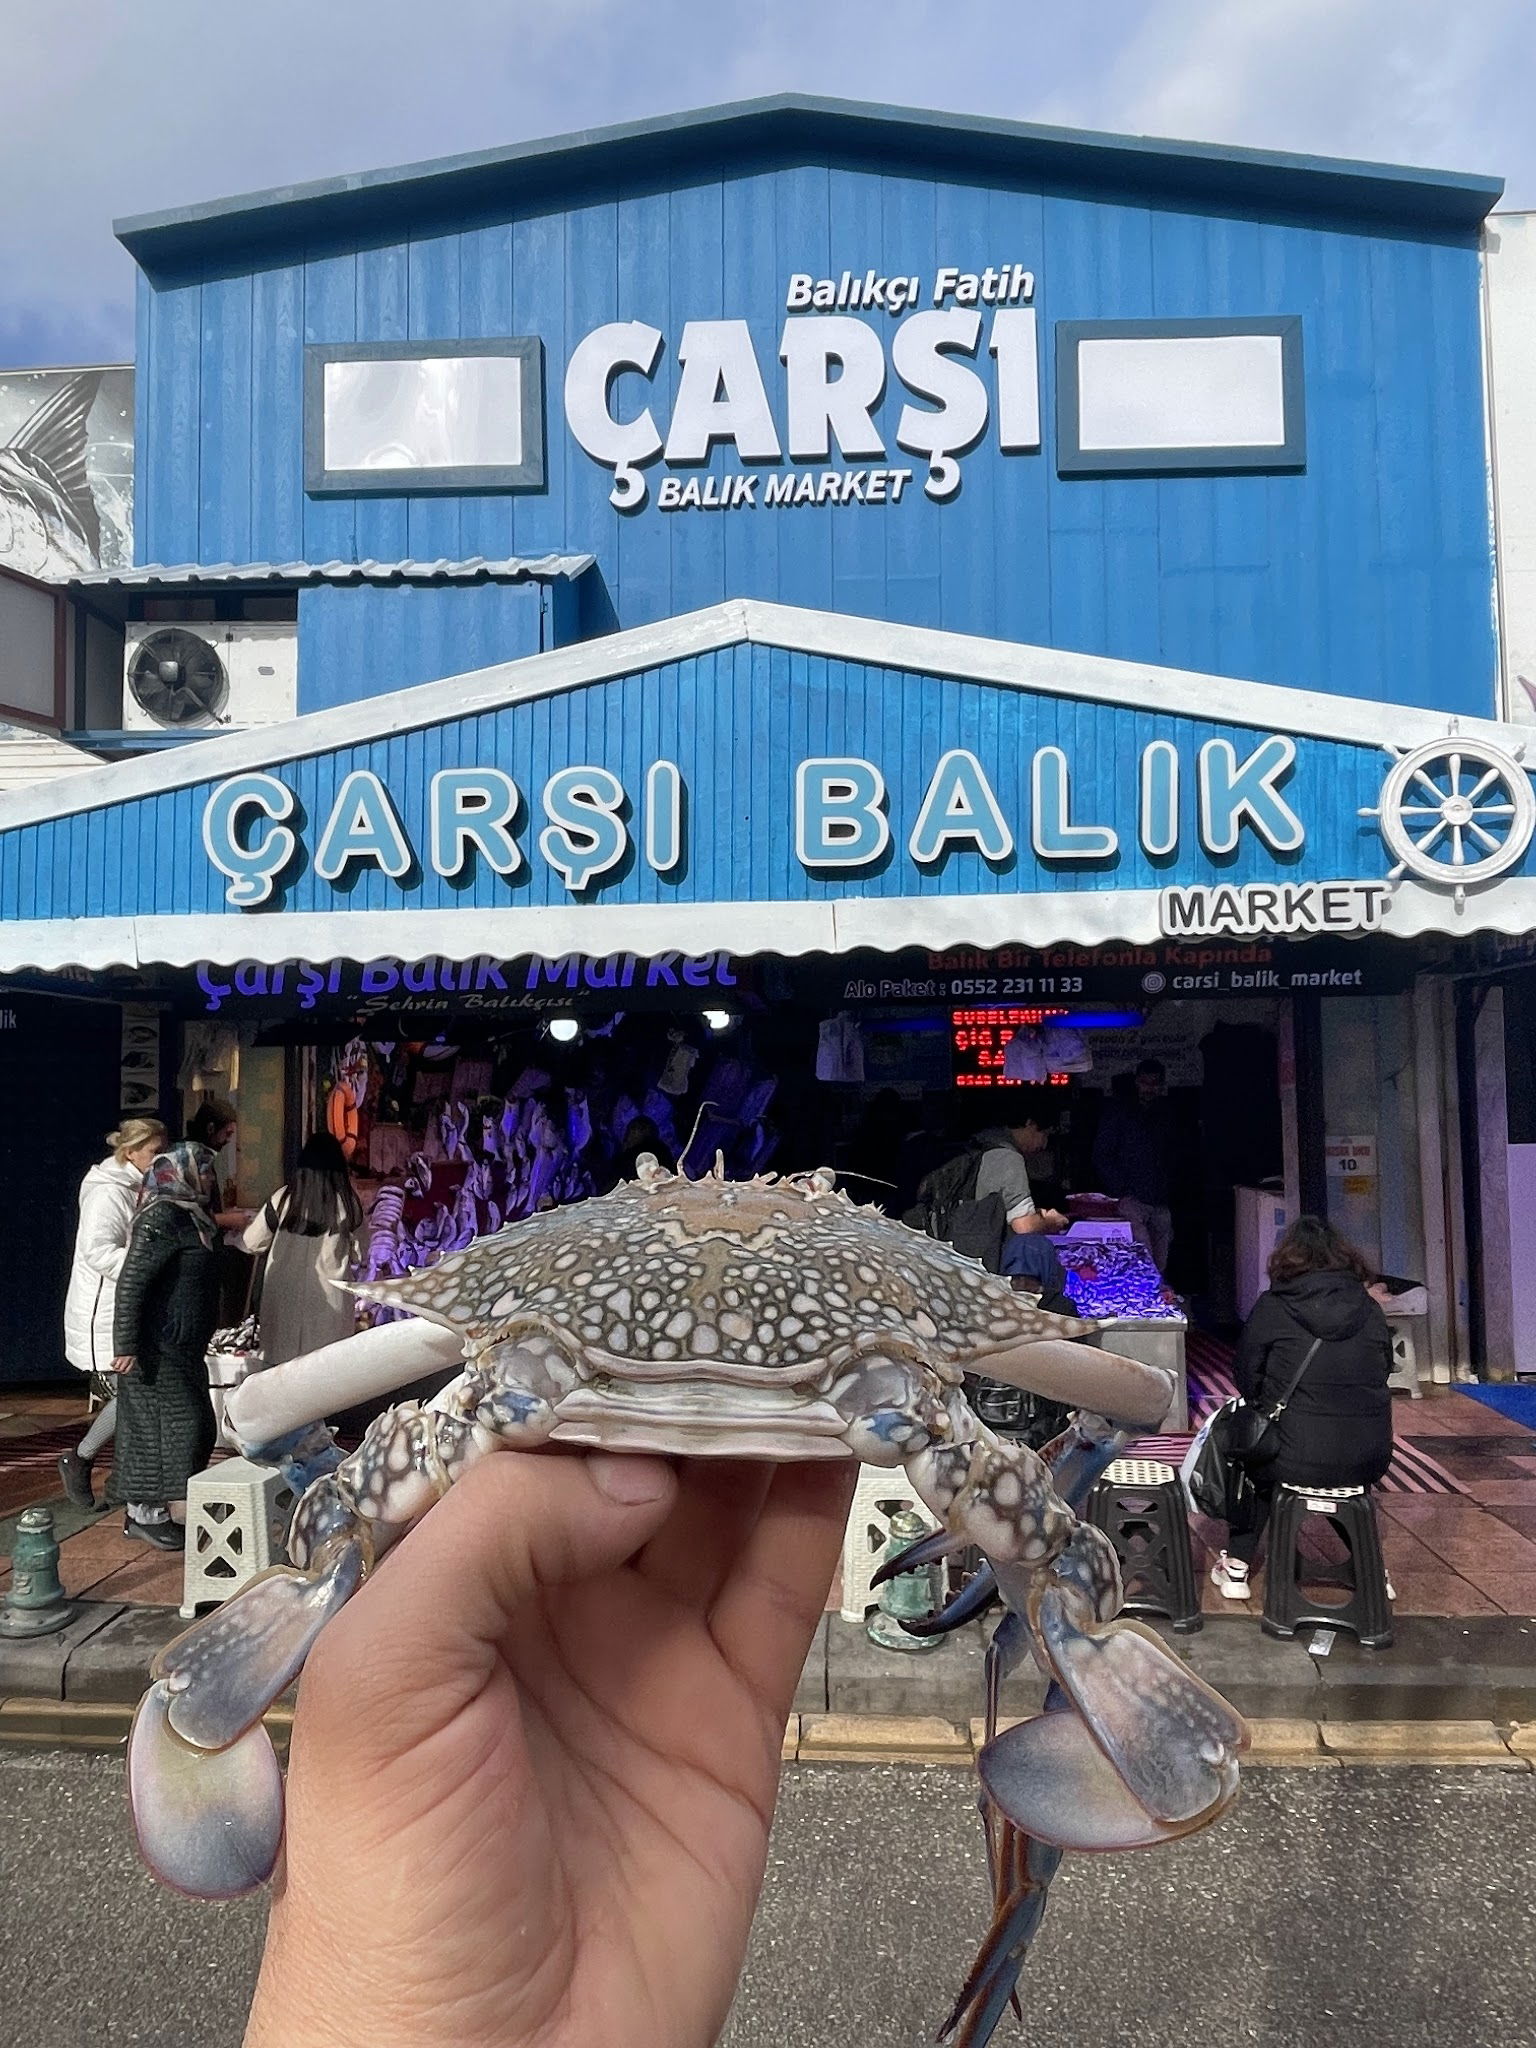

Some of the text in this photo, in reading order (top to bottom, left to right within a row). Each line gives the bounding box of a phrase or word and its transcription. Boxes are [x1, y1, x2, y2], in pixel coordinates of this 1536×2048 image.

[786, 264, 1035, 313] Balıkçı Fatih
[564, 305, 1041, 509] ÇARŞI
[658, 468, 912, 509] BALIK MARKET
[202, 735, 1305, 906] ÇARŞI BALIK
[1167, 886, 1385, 929] MARKET
[844, 980, 876, 998] Alo
[879, 979, 937, 998] Paket
[951, 979, 997, 996] 0552
[1003, 978, 1034, 995] 231
[1038, 977, 1055, 994] 11
[1060, 976, 1084, 994] 33
[1172, 967, 1363, 992] carsi_balik_market
[1338, 1158, 1358, 1171] 10
